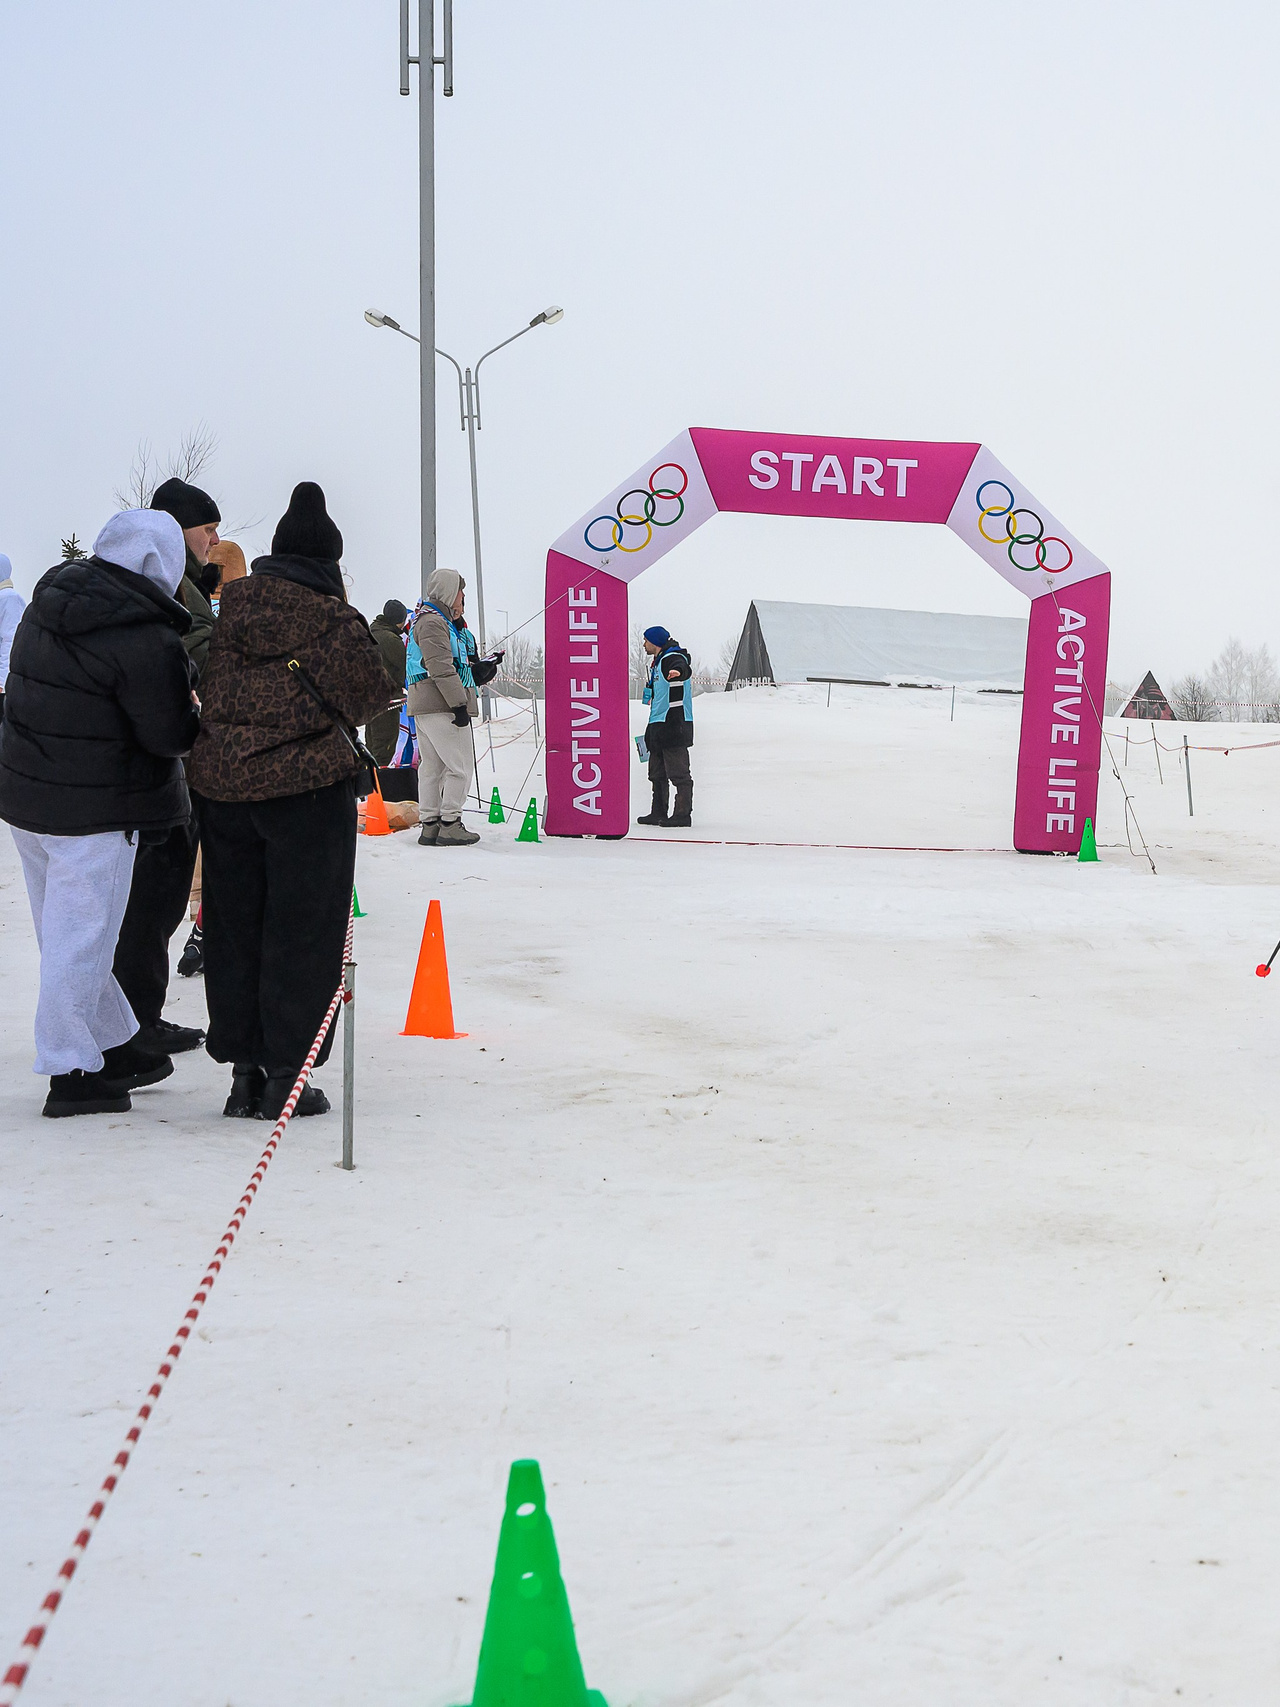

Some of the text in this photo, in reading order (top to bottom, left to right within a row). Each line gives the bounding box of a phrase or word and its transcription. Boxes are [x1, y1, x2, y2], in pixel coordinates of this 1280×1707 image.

[748, 450, 919, 498] START
[567, 586, 603, 816] ACTIVE LIFE
[1045, 607, 1087, 834] ACTIVE LIFE
